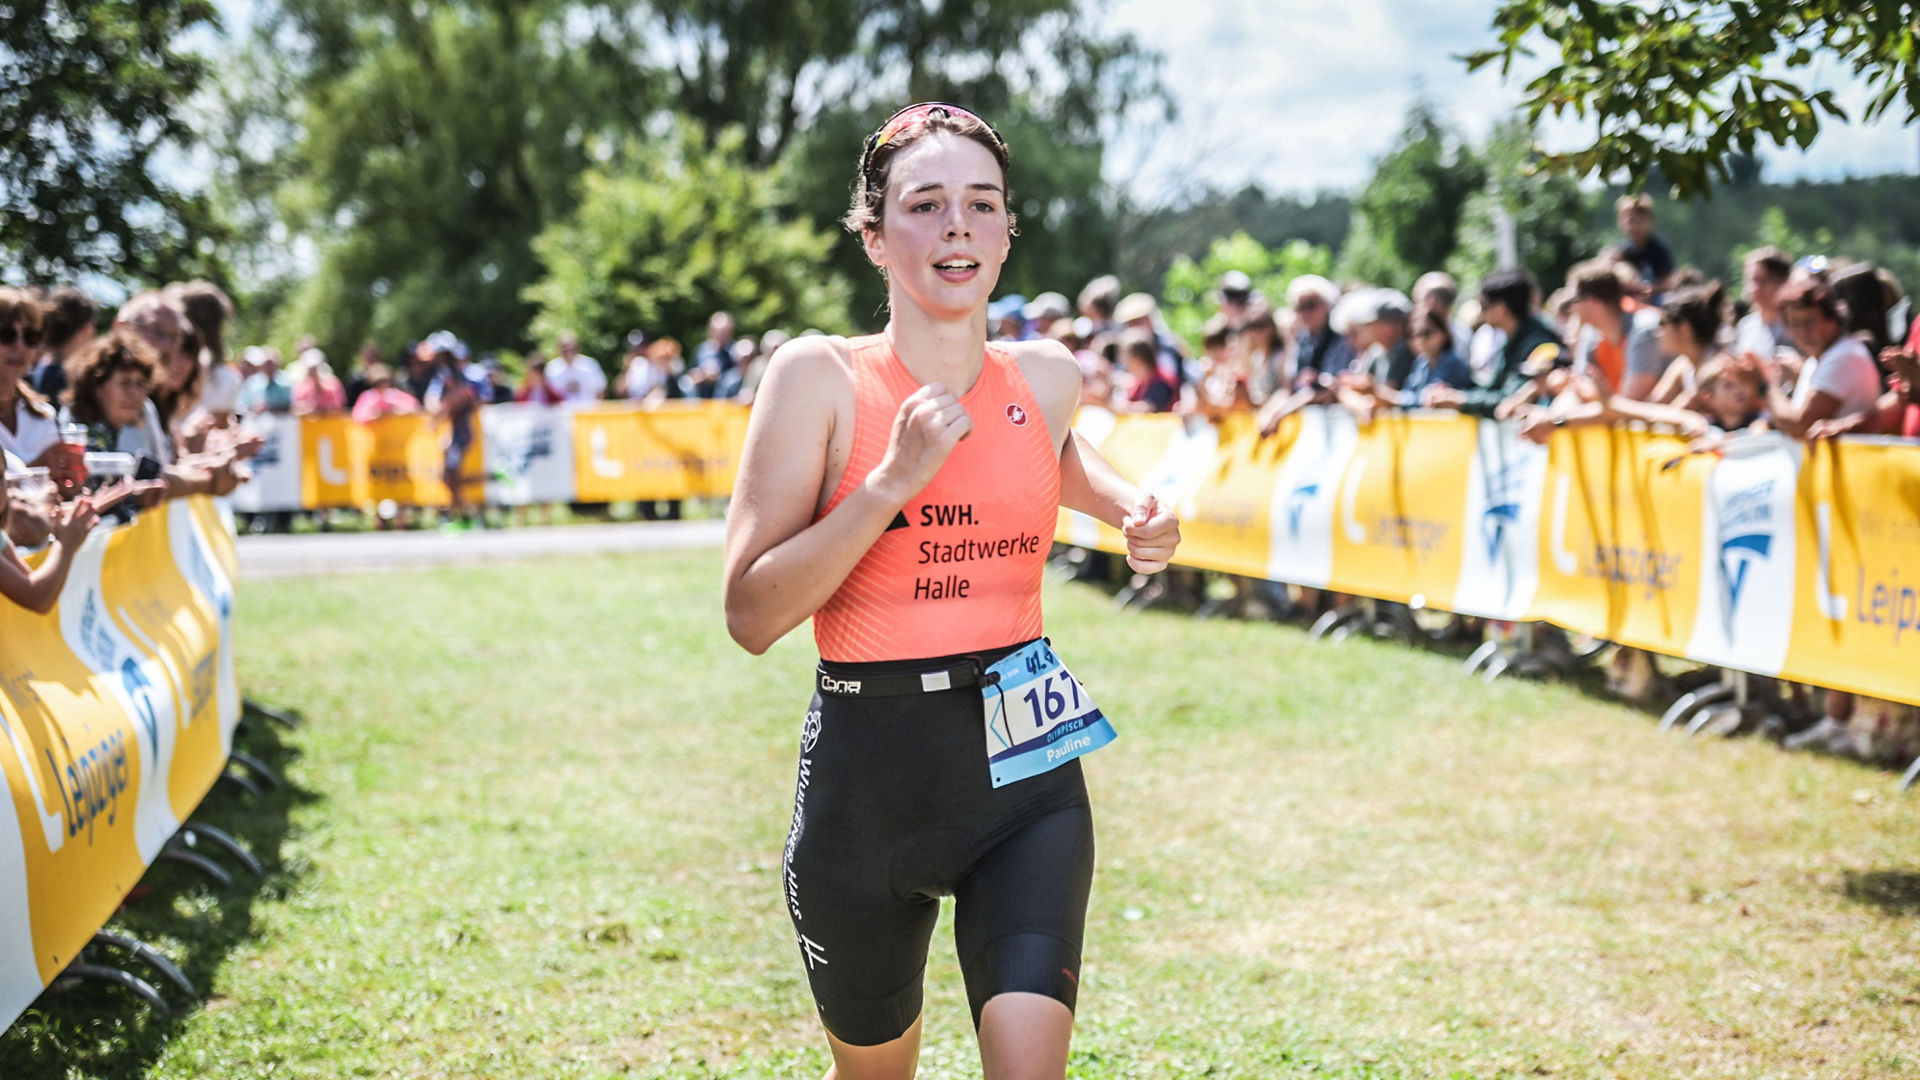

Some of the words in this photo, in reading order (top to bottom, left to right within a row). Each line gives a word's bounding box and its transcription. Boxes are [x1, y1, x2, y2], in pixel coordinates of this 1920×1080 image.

[920, 504, 979, 527] SWH.
[918, 532, 1040, 565] Stadtwerke
[914, 575, 970, 600] Halle
[1857, 564, 1920, 645] Leip
[1023, 670, 1080, 728] 167
[1045, 735, 1091, 763] Pauline
